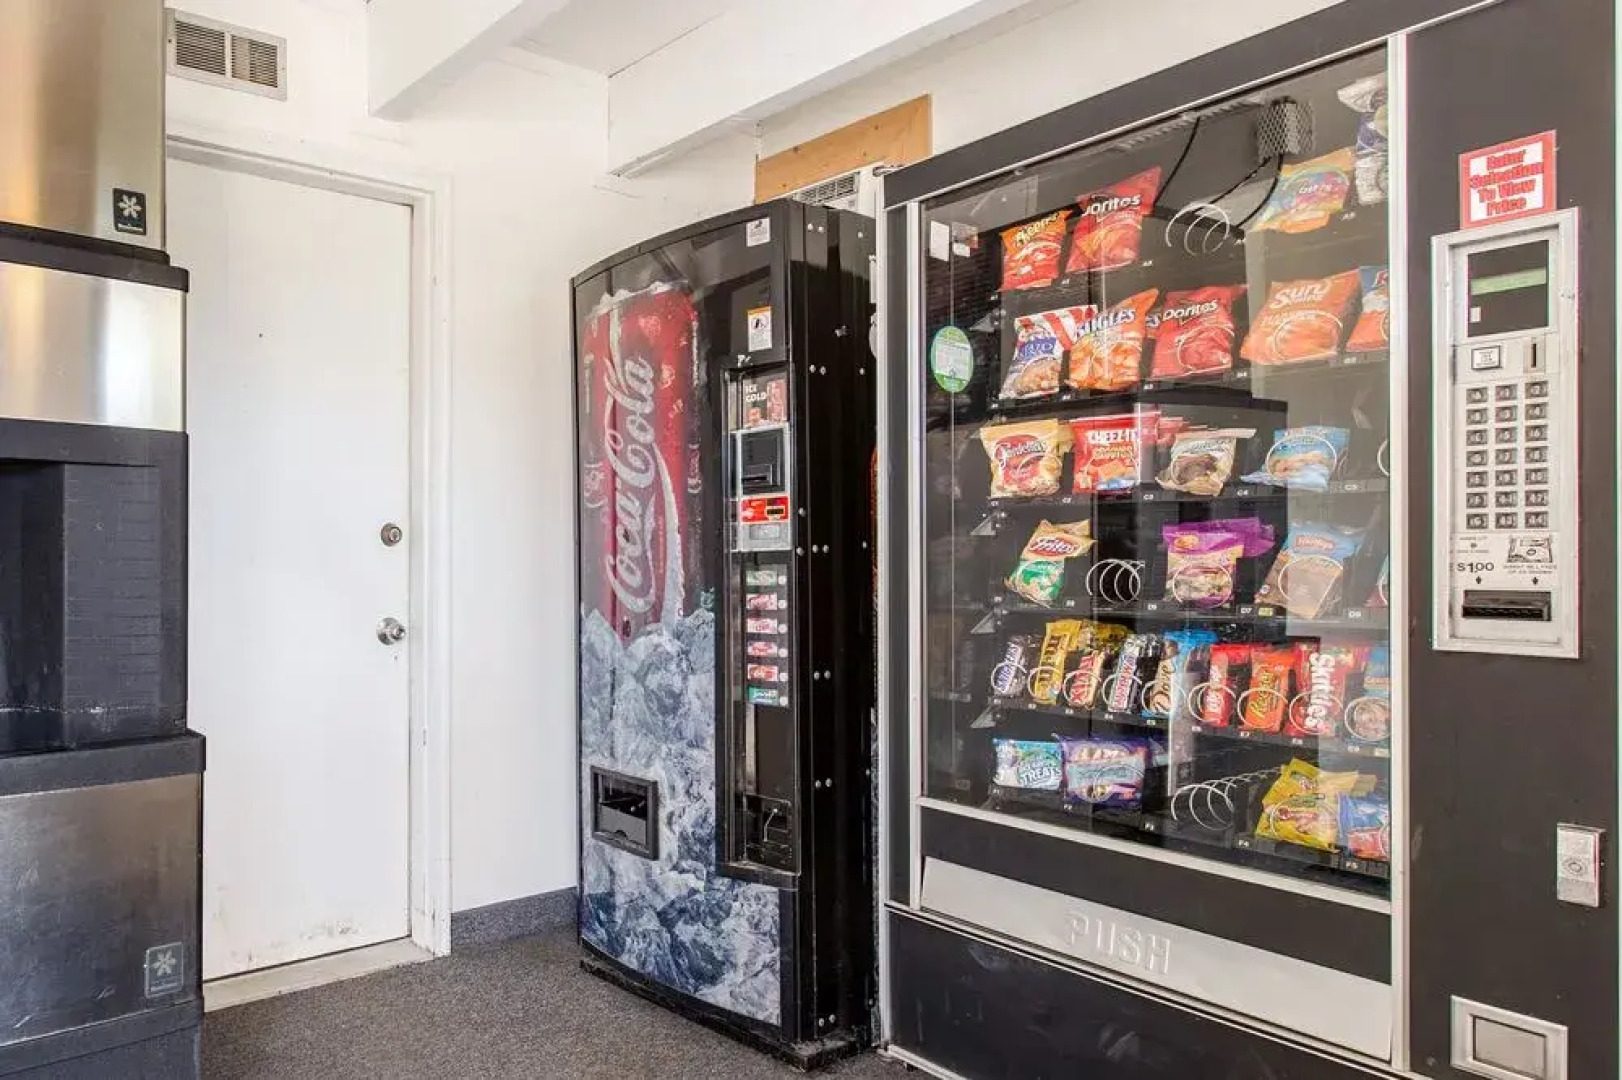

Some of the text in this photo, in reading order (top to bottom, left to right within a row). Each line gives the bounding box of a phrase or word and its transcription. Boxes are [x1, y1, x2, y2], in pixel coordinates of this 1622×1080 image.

[1486, 197, 1527, 216] Price
[1162, 299, 1218, 321] Doritos
[744, 384, 759, 394] ICE
[745, 392, 767, 403] COLD
[1064, 910, 1171, 974] PUSH
